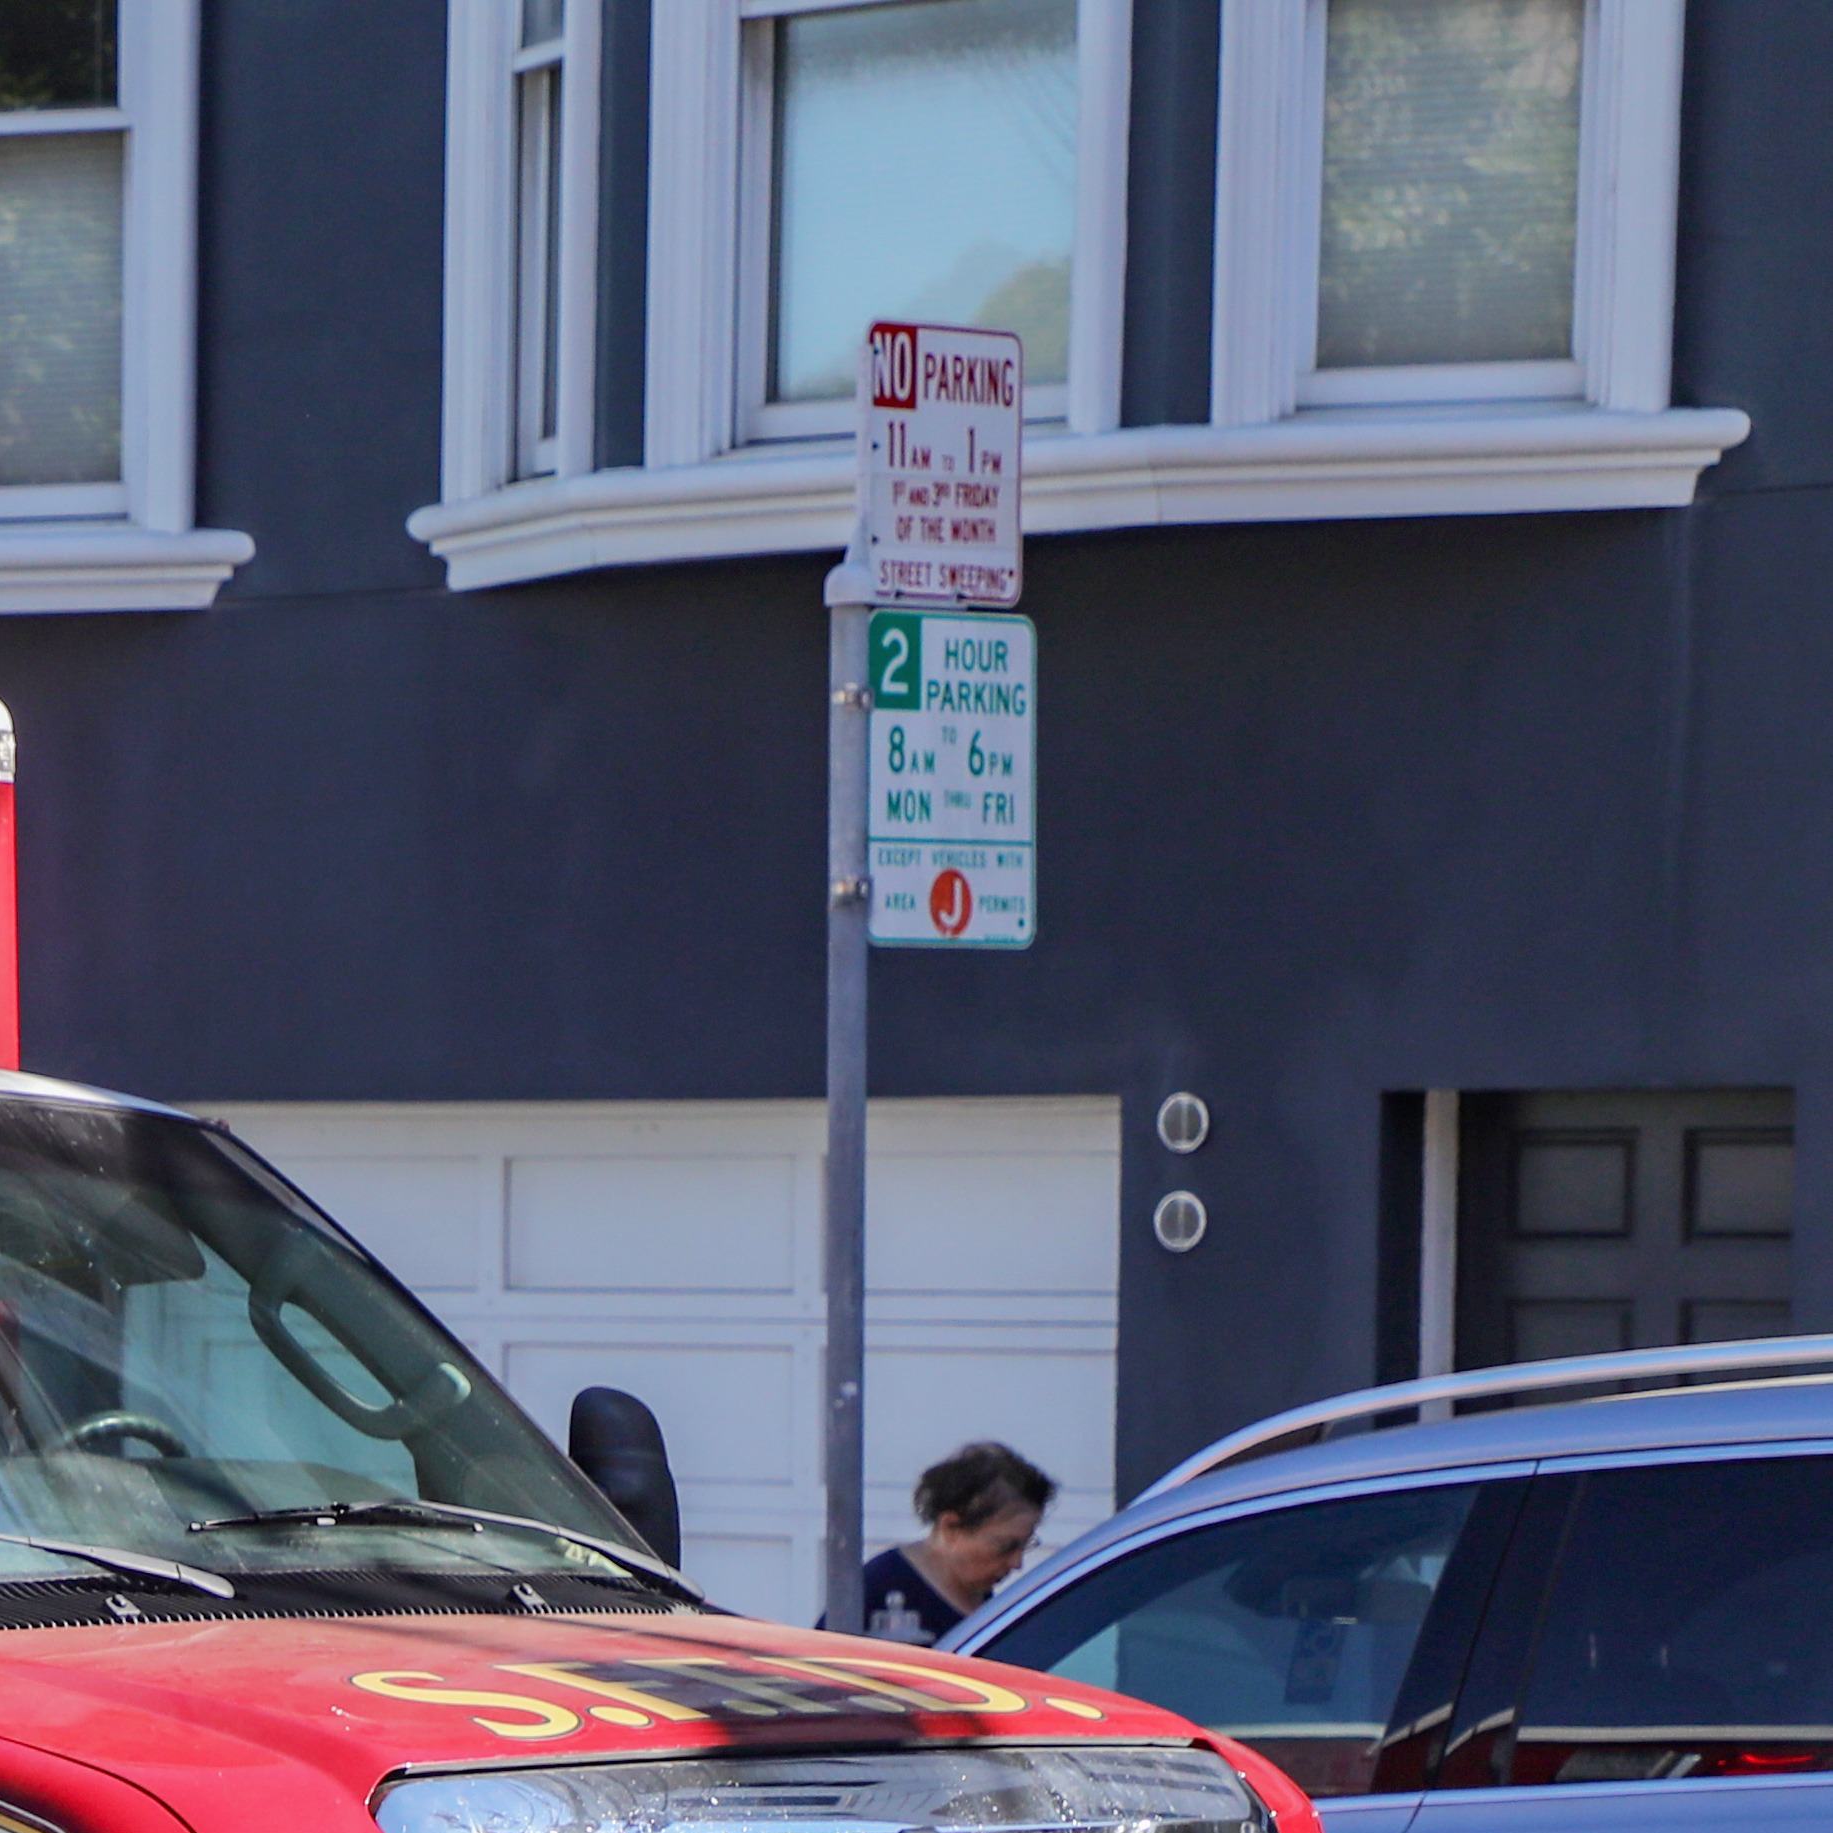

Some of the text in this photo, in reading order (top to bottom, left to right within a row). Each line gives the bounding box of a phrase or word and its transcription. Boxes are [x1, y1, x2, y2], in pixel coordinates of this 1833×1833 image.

[874, 331, 1014, 408] NO PARKING
[955, 482, 1000, 508] FRIDAY
[896, 515, 996, 544] OF THE MONTH
[880, 559, 1007, 592] STREET SWEEPING
[881, 628, 1008, 694] 2 HOUR
[927, 679, 1026, 717] PARKING
[887, 789, 932, 823] MON
[983, 791, 1014, 824] FRI
[878, 849, 921, 867] EXCEPT
[932, 850, 987, 869] VEHICLES
[885, 892, 916, 911] AREA
[938, 877, 963, 927] J
